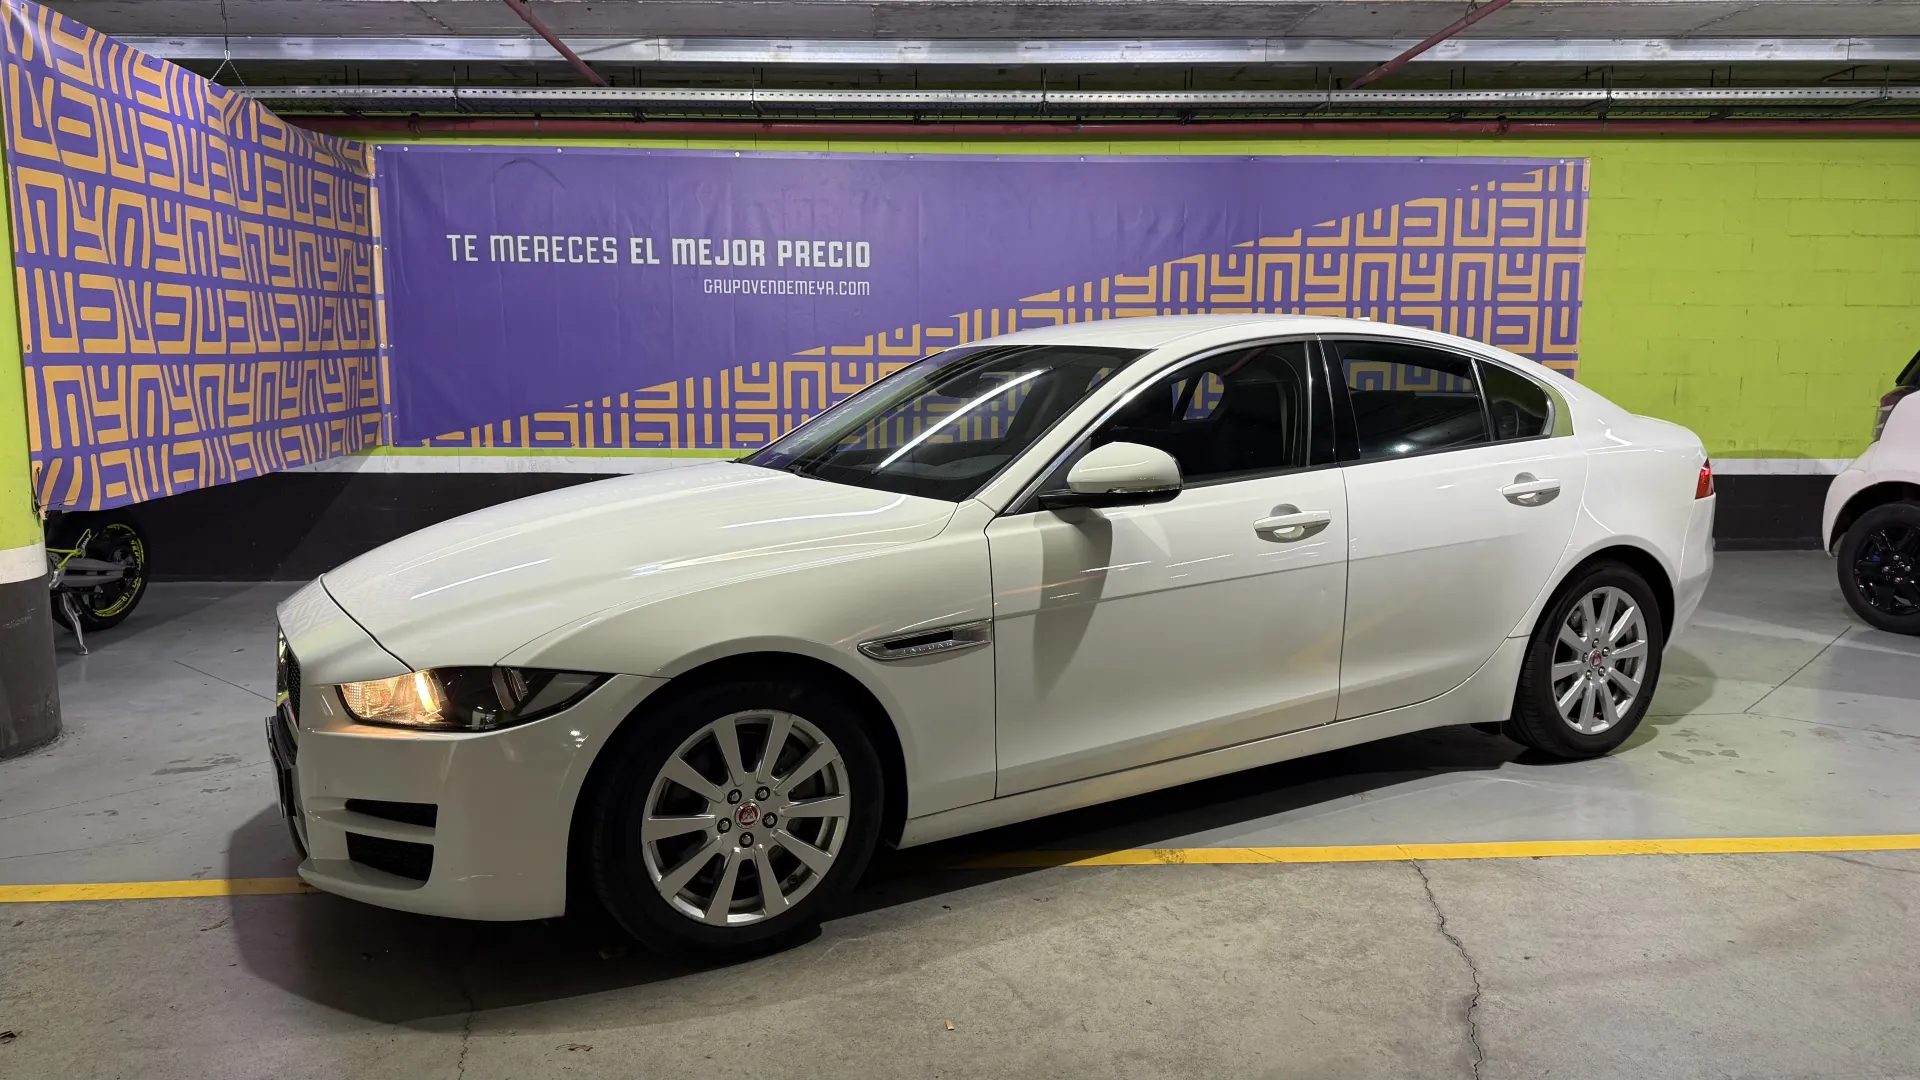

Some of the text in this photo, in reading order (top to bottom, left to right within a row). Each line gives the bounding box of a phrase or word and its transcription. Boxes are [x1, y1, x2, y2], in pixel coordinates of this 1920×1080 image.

[446, 234, 871, 268] TE MERECES EL MEJOR PRECIO
[703, 278, 870, 296] GRUPOVENDEMEYA.COM
